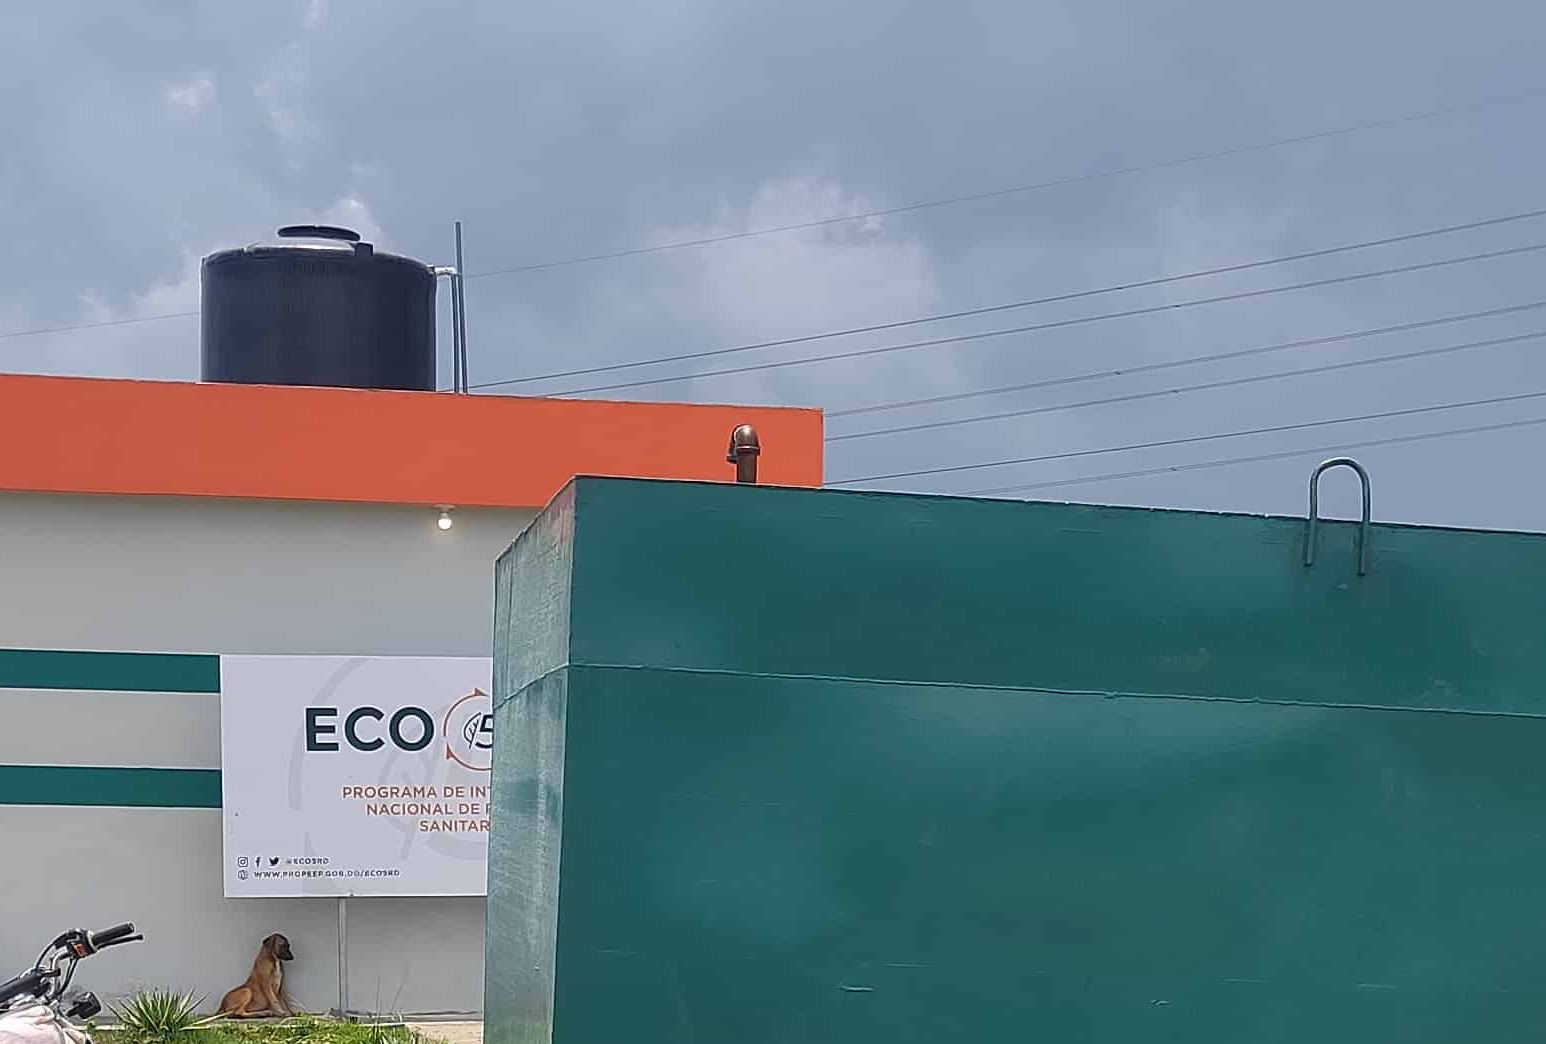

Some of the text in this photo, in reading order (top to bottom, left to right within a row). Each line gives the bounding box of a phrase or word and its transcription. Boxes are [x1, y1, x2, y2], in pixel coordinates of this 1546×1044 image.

[306, 706, 435, 751] ECO
[342, 785, 492, 799] PROGRAMA DE IN
[366, 803, 453, 815] NACIONAL
[459, 803, 480, 815] DE
